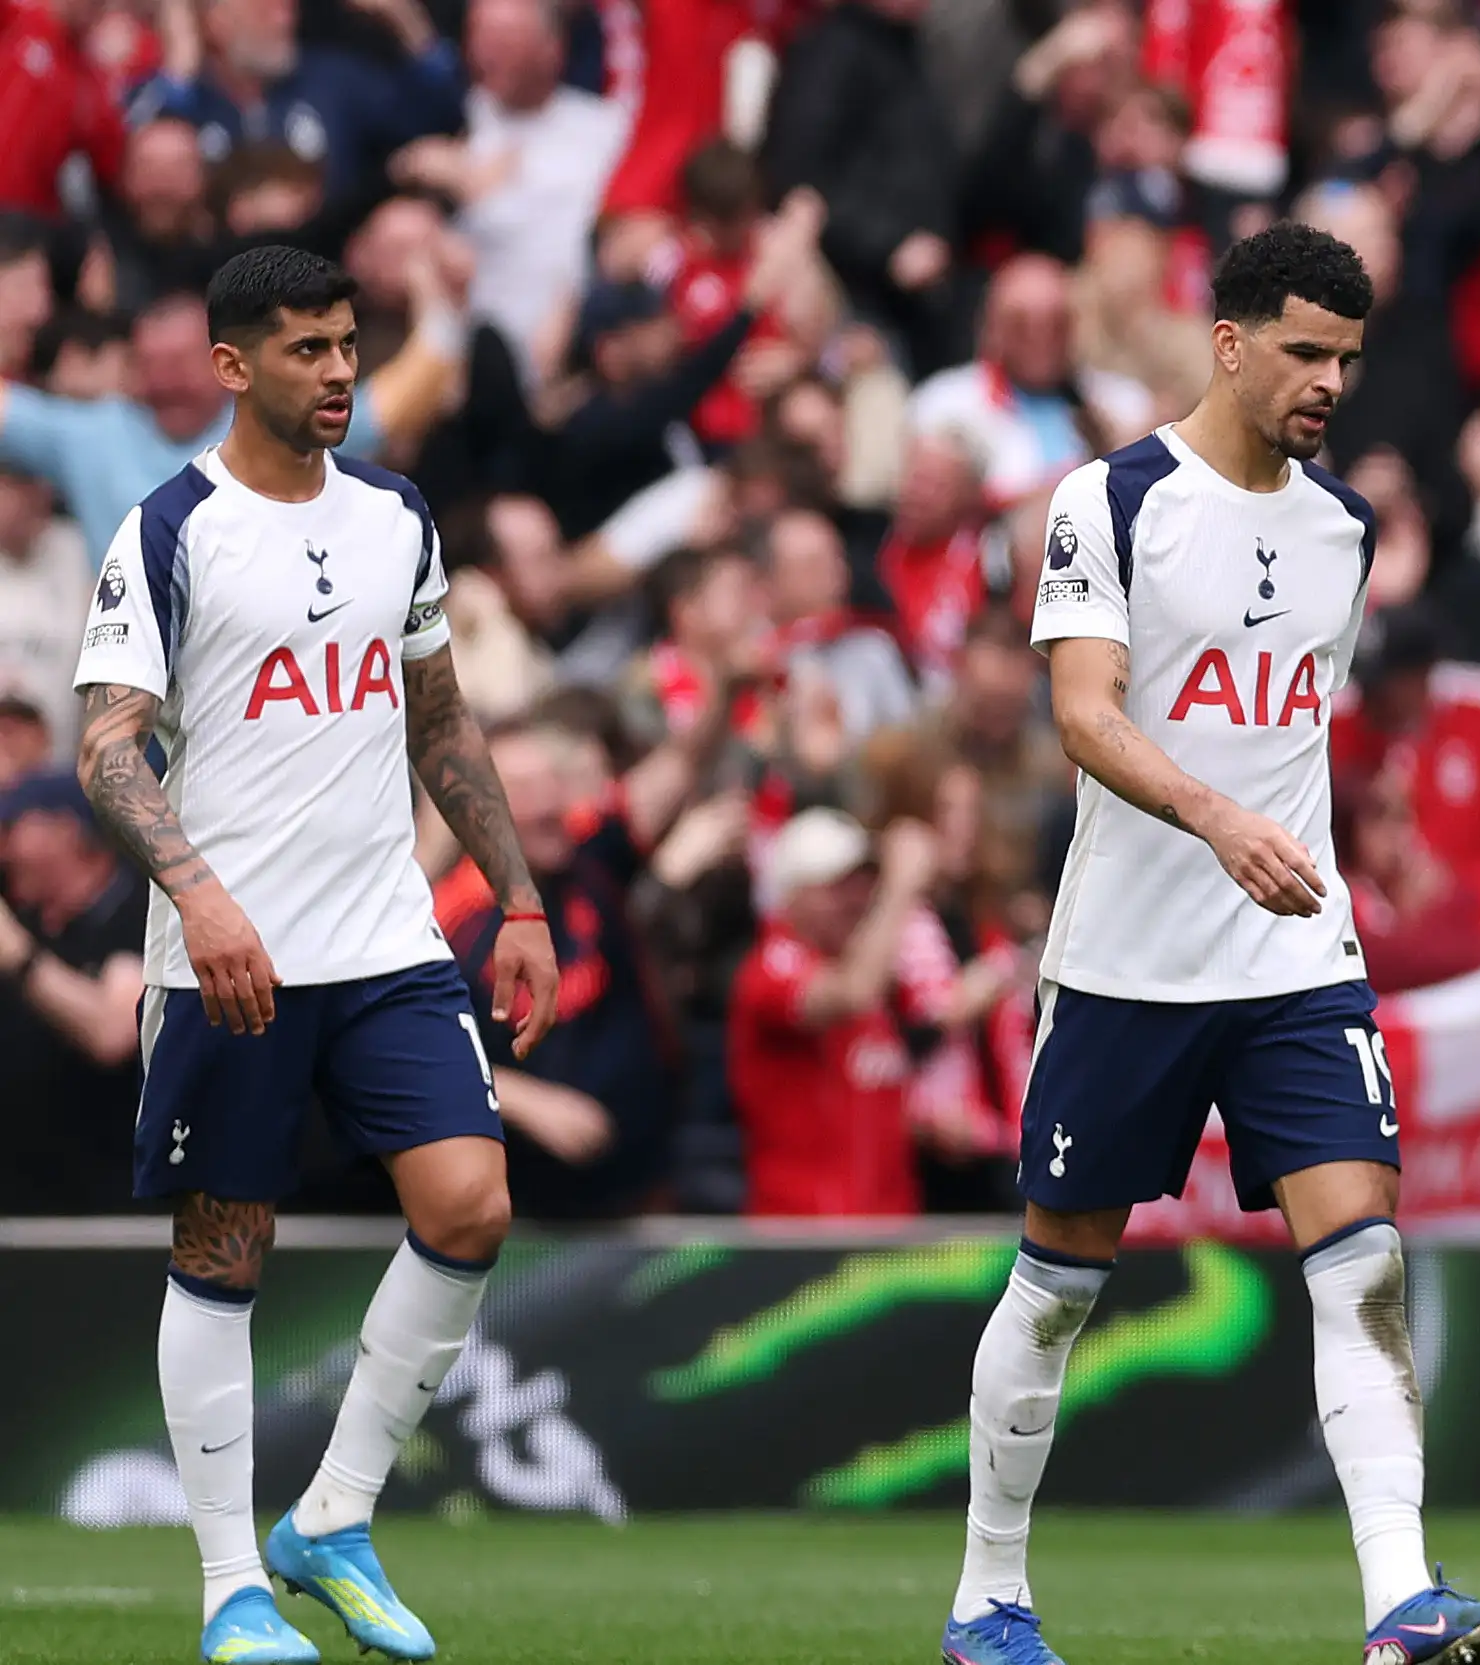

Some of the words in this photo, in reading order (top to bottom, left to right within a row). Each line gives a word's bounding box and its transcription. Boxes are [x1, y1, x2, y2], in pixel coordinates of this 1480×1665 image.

[1048, 581, 1083, 592] room
[245, 638, 399, 720] AIA
[1168, 647, 1321, 727] AIA
